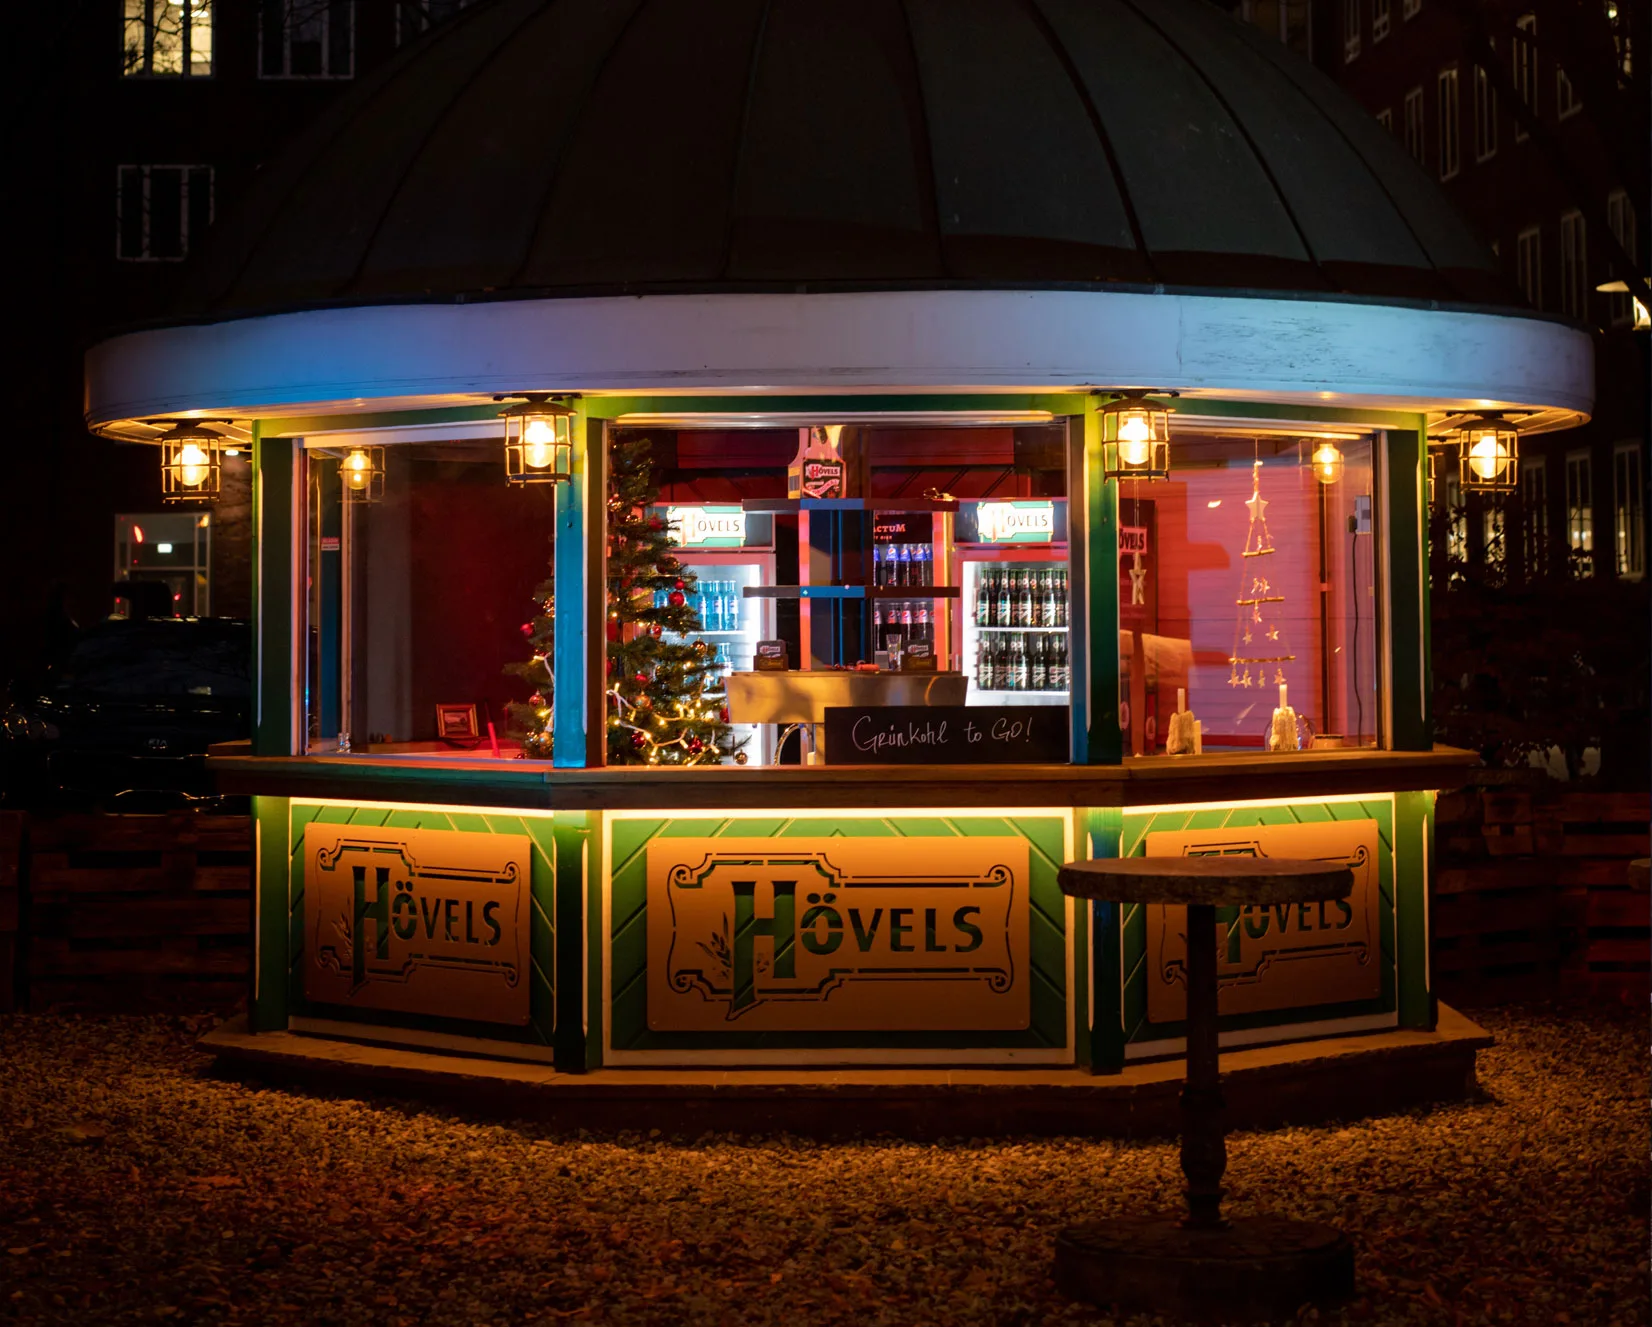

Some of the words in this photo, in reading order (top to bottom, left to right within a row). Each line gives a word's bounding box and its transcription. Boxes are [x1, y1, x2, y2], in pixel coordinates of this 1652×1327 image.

[963, 720, 983, 743] to
[352, 866, 501, 987] HÖVELS
[731, 880, 984, 1011] HÖVELS
